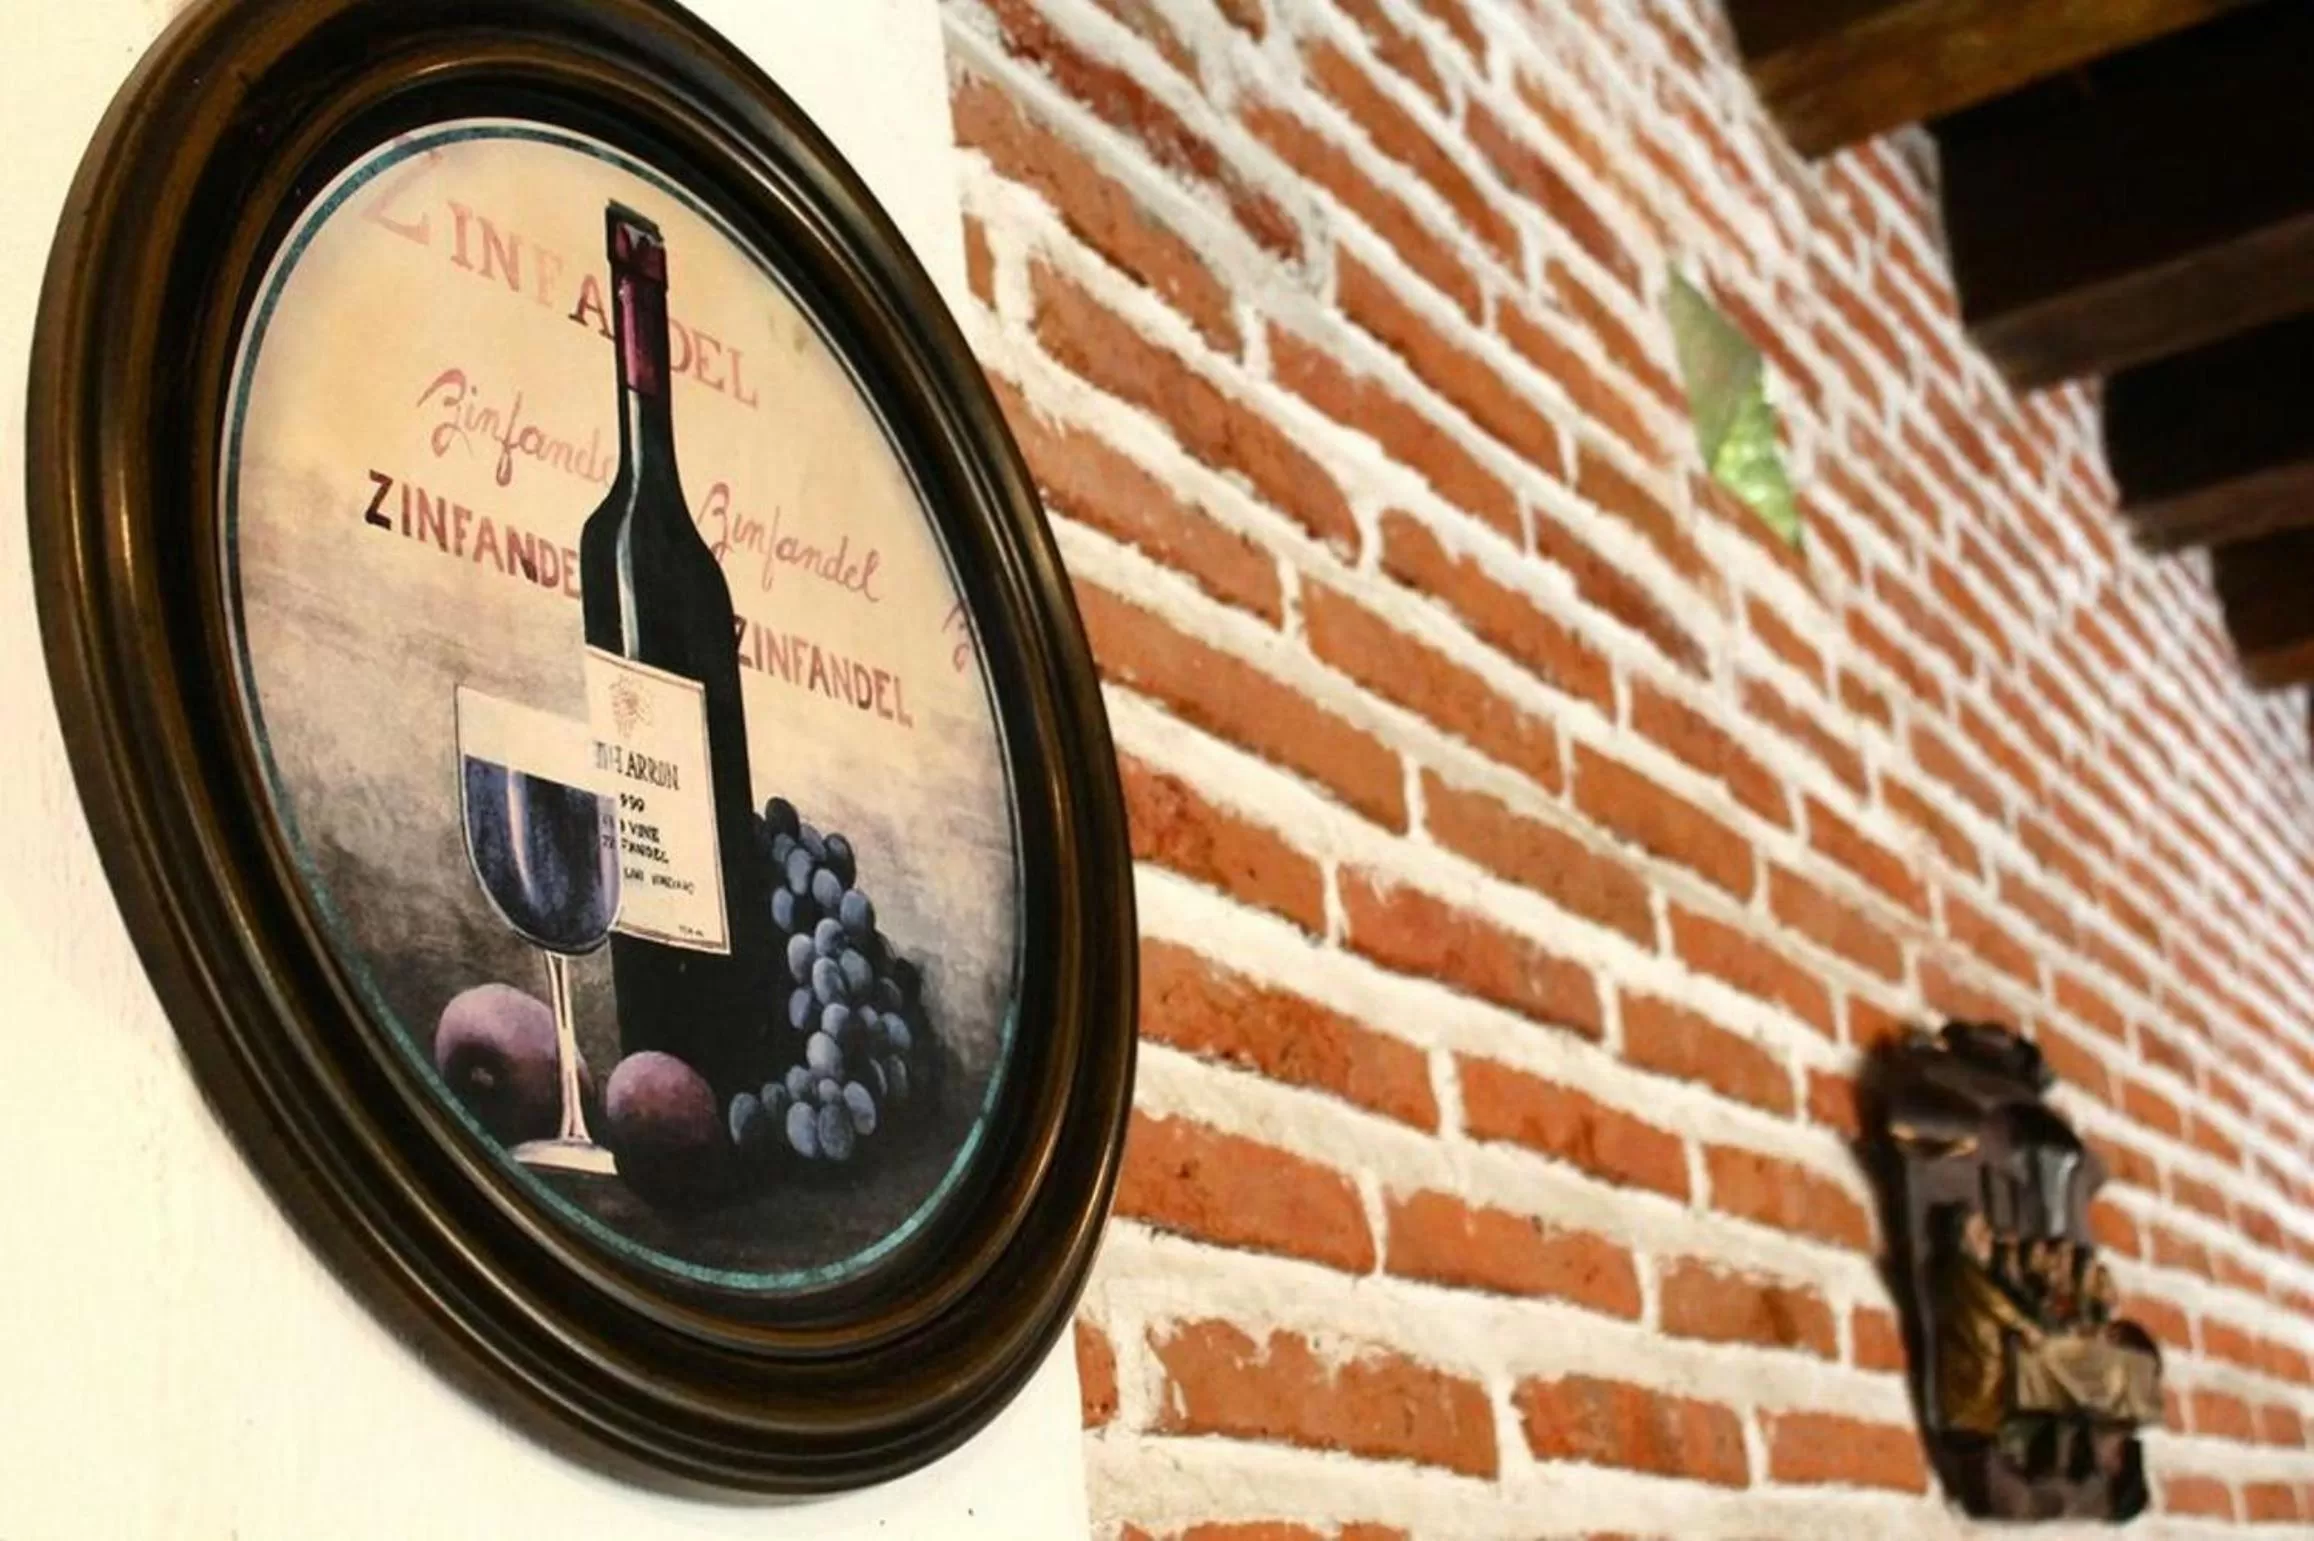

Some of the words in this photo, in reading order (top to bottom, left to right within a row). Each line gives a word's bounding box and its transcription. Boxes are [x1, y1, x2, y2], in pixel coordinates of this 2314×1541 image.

[360, 148, 760, 410] ZINFADEL
[417, 368, 617, 489] Zinfande
[364, 469, 582, 601] ZINFANDE
[699, 482, 880, 603] Zinfandel
[732, 612, 914, 729] ZINFANDEL
